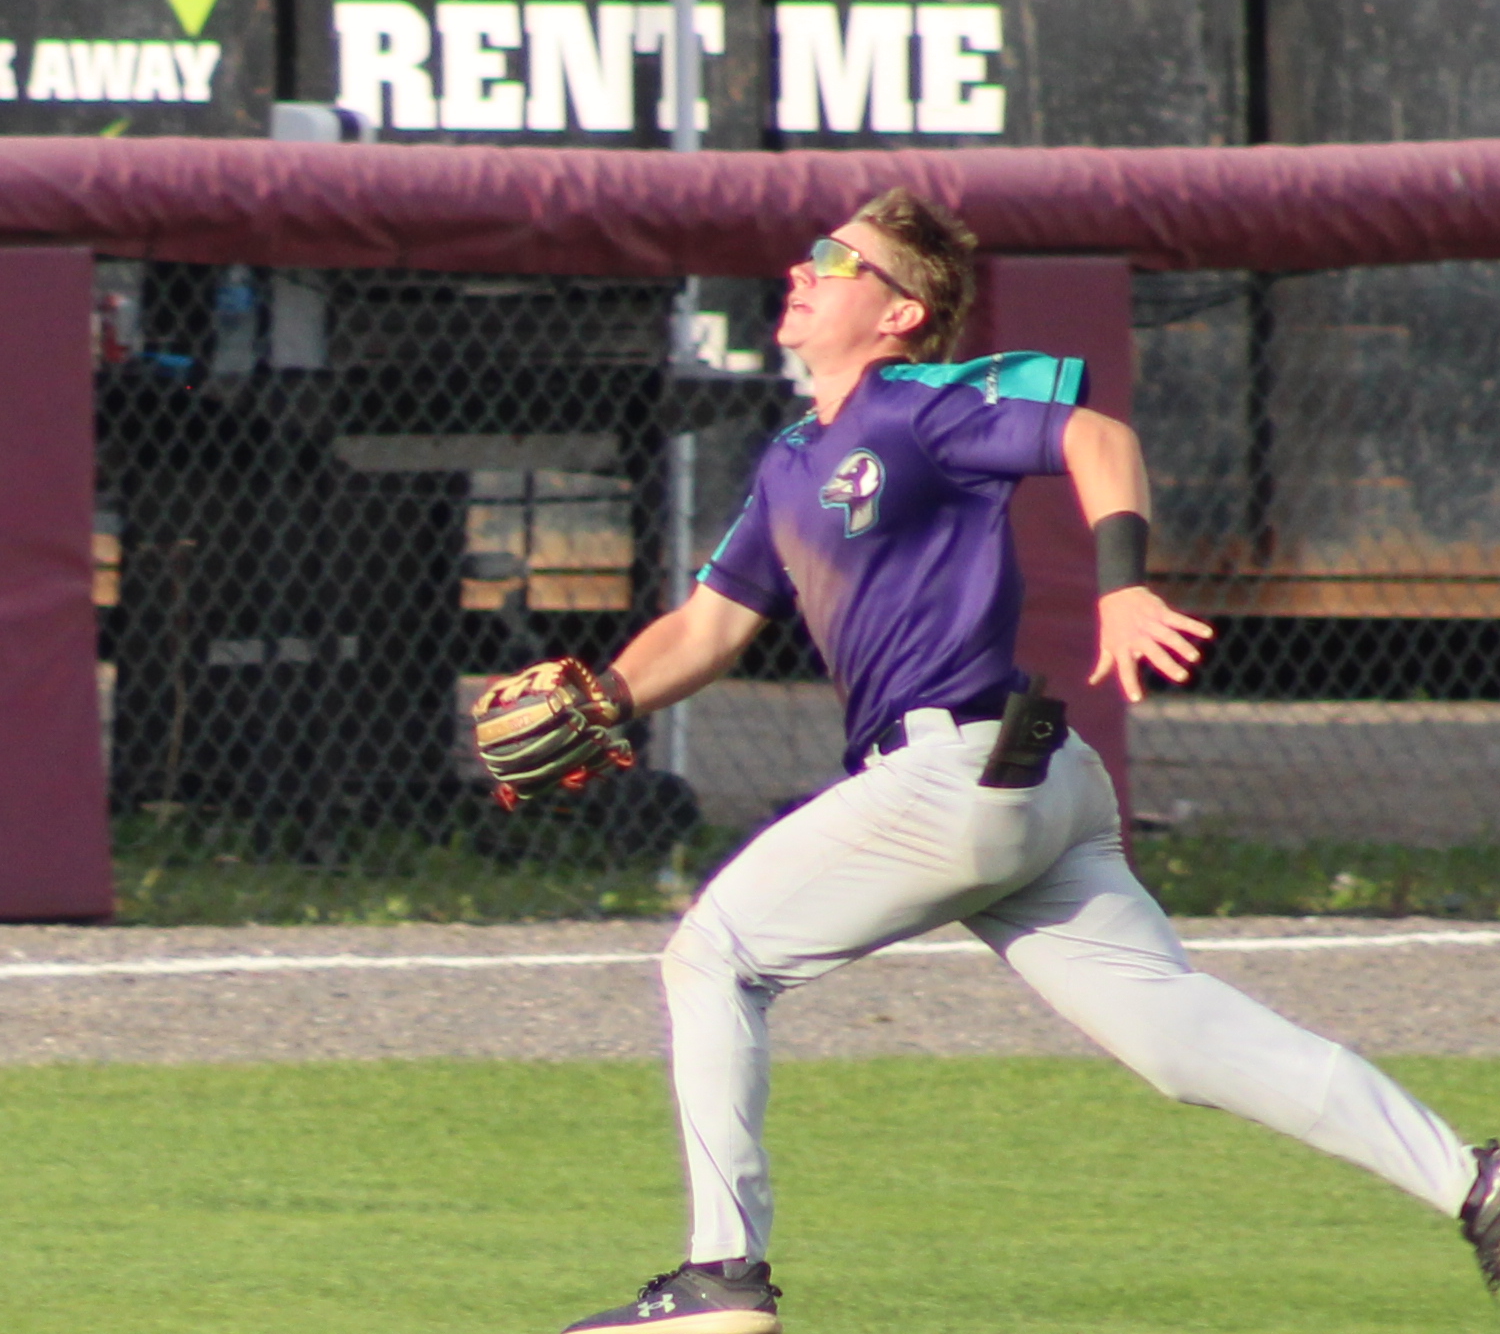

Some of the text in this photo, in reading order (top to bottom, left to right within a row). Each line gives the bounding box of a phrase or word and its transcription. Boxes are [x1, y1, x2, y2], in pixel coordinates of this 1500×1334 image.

[28, 41, 220, 101] AWAY
[334, 0, 1005, 133] RENT ME
